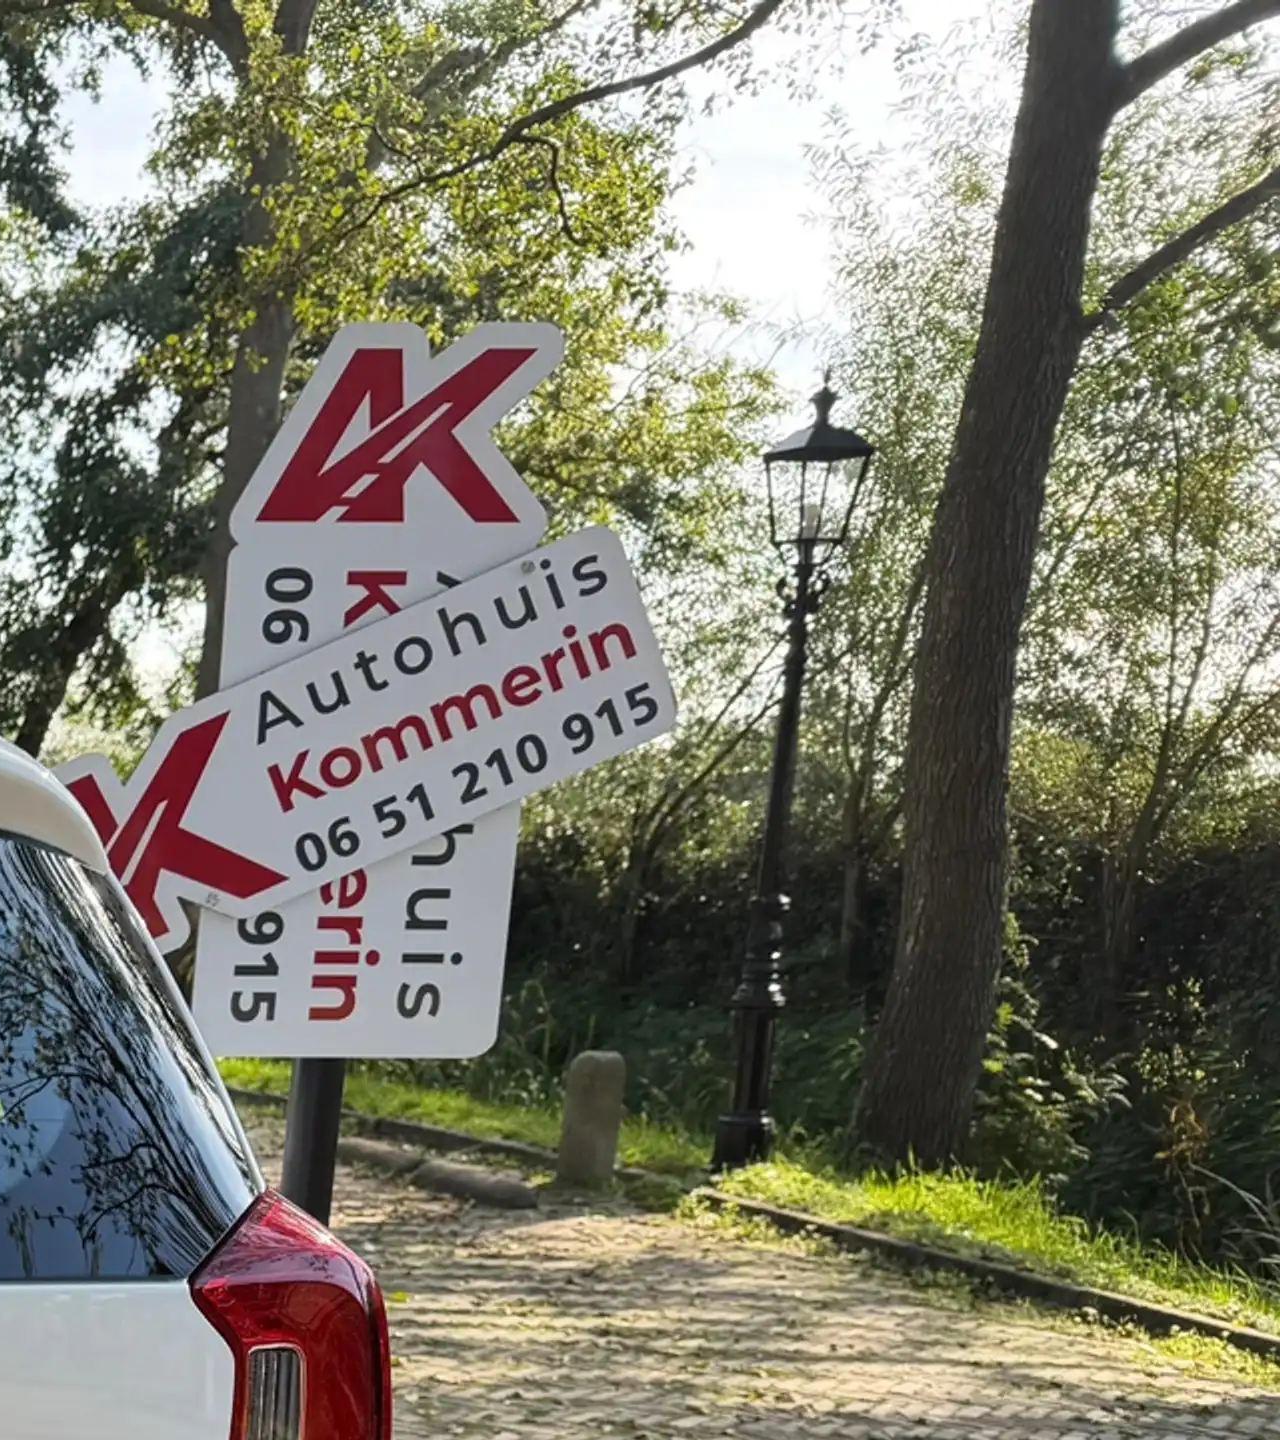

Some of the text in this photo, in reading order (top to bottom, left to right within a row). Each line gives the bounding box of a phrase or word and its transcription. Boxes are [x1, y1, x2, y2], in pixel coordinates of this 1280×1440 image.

[255, 347, 539, 523] AK
[256, 554, 609, 746] Autohuis
[267, 623, 637, 813] Kommerin
[230, 567, 314, 1022] 06 915
[295, 682, 659, 872] 06 51 210 915
